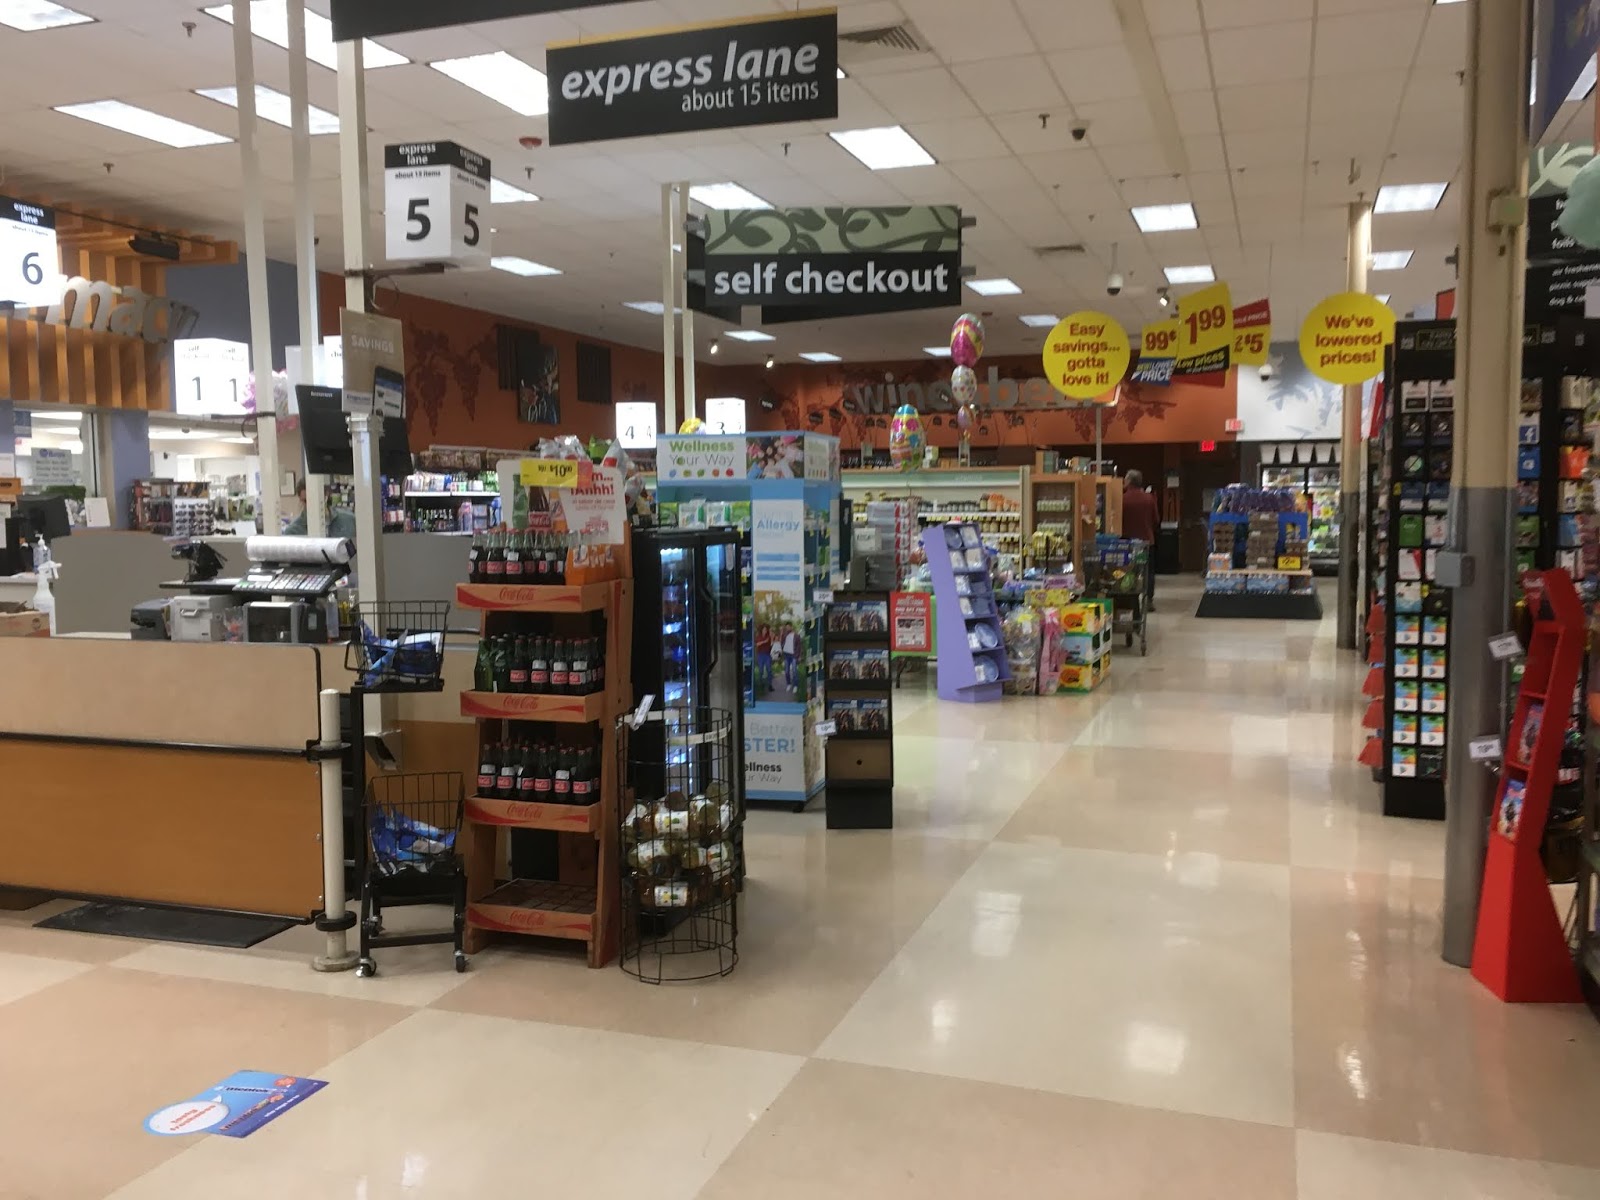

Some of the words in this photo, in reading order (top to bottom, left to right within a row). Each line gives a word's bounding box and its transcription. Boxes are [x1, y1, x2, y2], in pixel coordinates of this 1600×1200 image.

[561, 54, 712, 106] express
[722, 40, 819, 83] lane
[681, 87, 735, 112] about
[739, 84, 761, 107] 15
[766, 80, 819, 105] items
[399, 143, 436, 155] express
[406, 154, 428, 166] lane
[13, 202, 45, 218] express
[20, 212, 39, 225] lane
[406, 198, 431, 241] 5
[463, 203, 480, 247] 5
[22, 252, 44, 285] 6
[714, 261, 778, 295] self
[784, 260, 949, 295] checkout
[1069, 322, 1106, 337] Easy
[1325, 314, 1375, 329] We've
[351, 333, 394, 354] SAVINGS
[1315, 331, 1383, 348] lowered
[1066, 357, 1106, 373] gotta
[1320, 350, 1377, 368] prices!
[1062, 374, 1092, 386] love
[1095, 371, 1109, 385] it!
[191, 375, 202, 401] 1
[229, 377, 238, 403] 1
[669, 440, 735, 452] Wellness
[669, 453, 705, 466] Your
[705, 453, 735, 467] Way
[757, 519, 800, 532] Allergy
[745, 761, 782, 773] ellness
